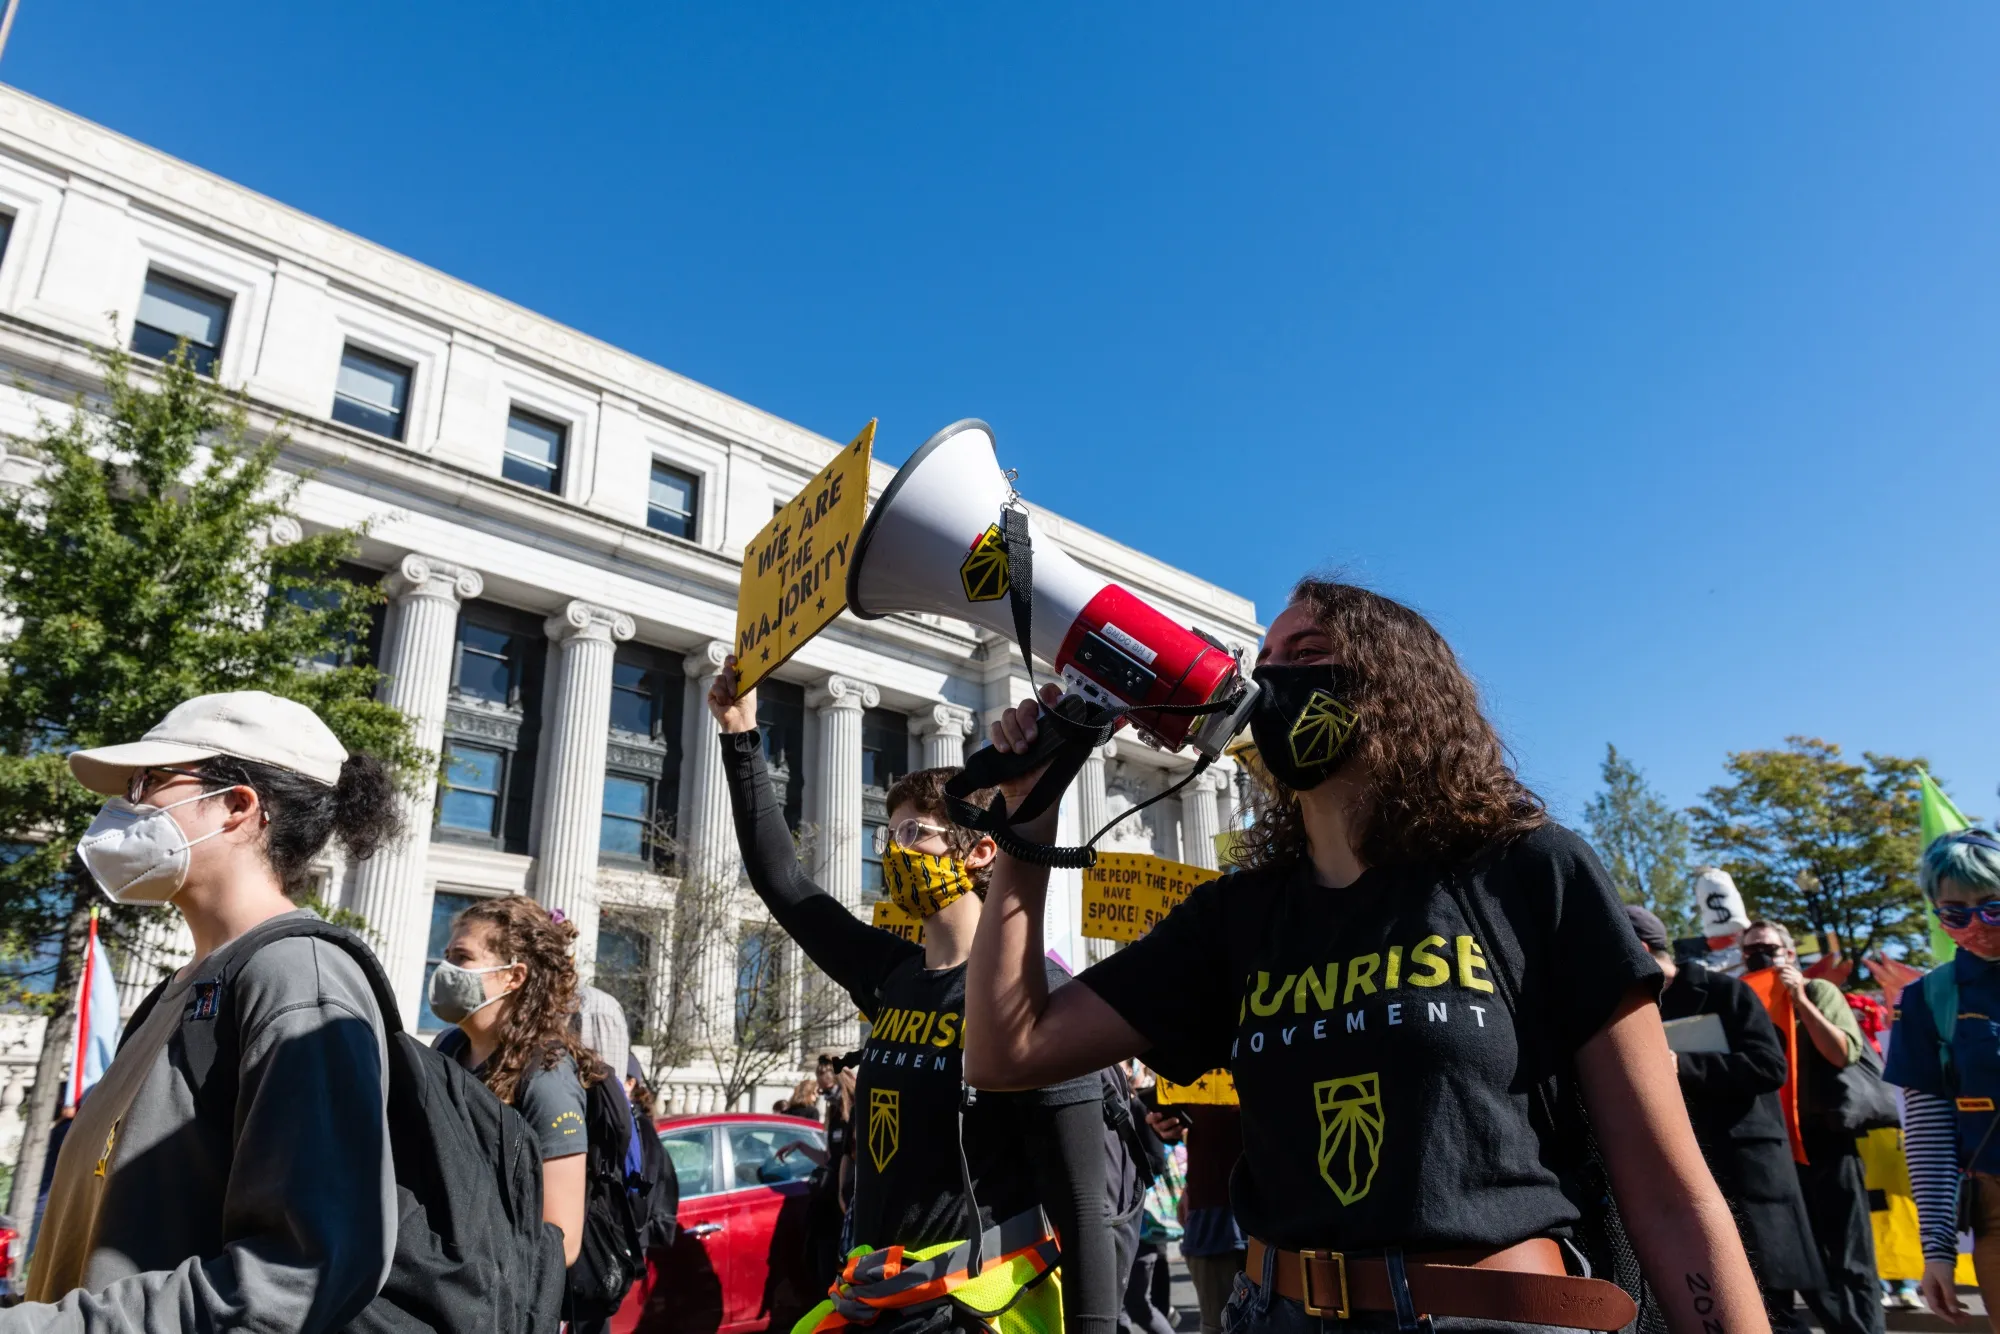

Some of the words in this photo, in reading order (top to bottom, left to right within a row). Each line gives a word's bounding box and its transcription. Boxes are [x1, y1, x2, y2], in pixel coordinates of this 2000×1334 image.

[758, 524, 791, 578] WE
[798, 472, 843, 541] ARE
[778, 535, 813, 588] THE
[739, 532, 850, 660] MAJORITY
[1087, 868, 1106, 882] THE
[1109, 868, 1141, 885] PEOPL
[1145, 872, 1166, 892] THE
[1169, 878, 1196, 897] PEO
[1103, 886, 1131, 900] HAVE
[1162, 895, 1183, 910] HA
[1088, 902, 1139, 924] SPOKE
[1239, 934, 1495, 1026] UNRISE
[871, 1003, 966, 1050] UNRIS
[862, 1047, 946, 1072] OVEMEN
